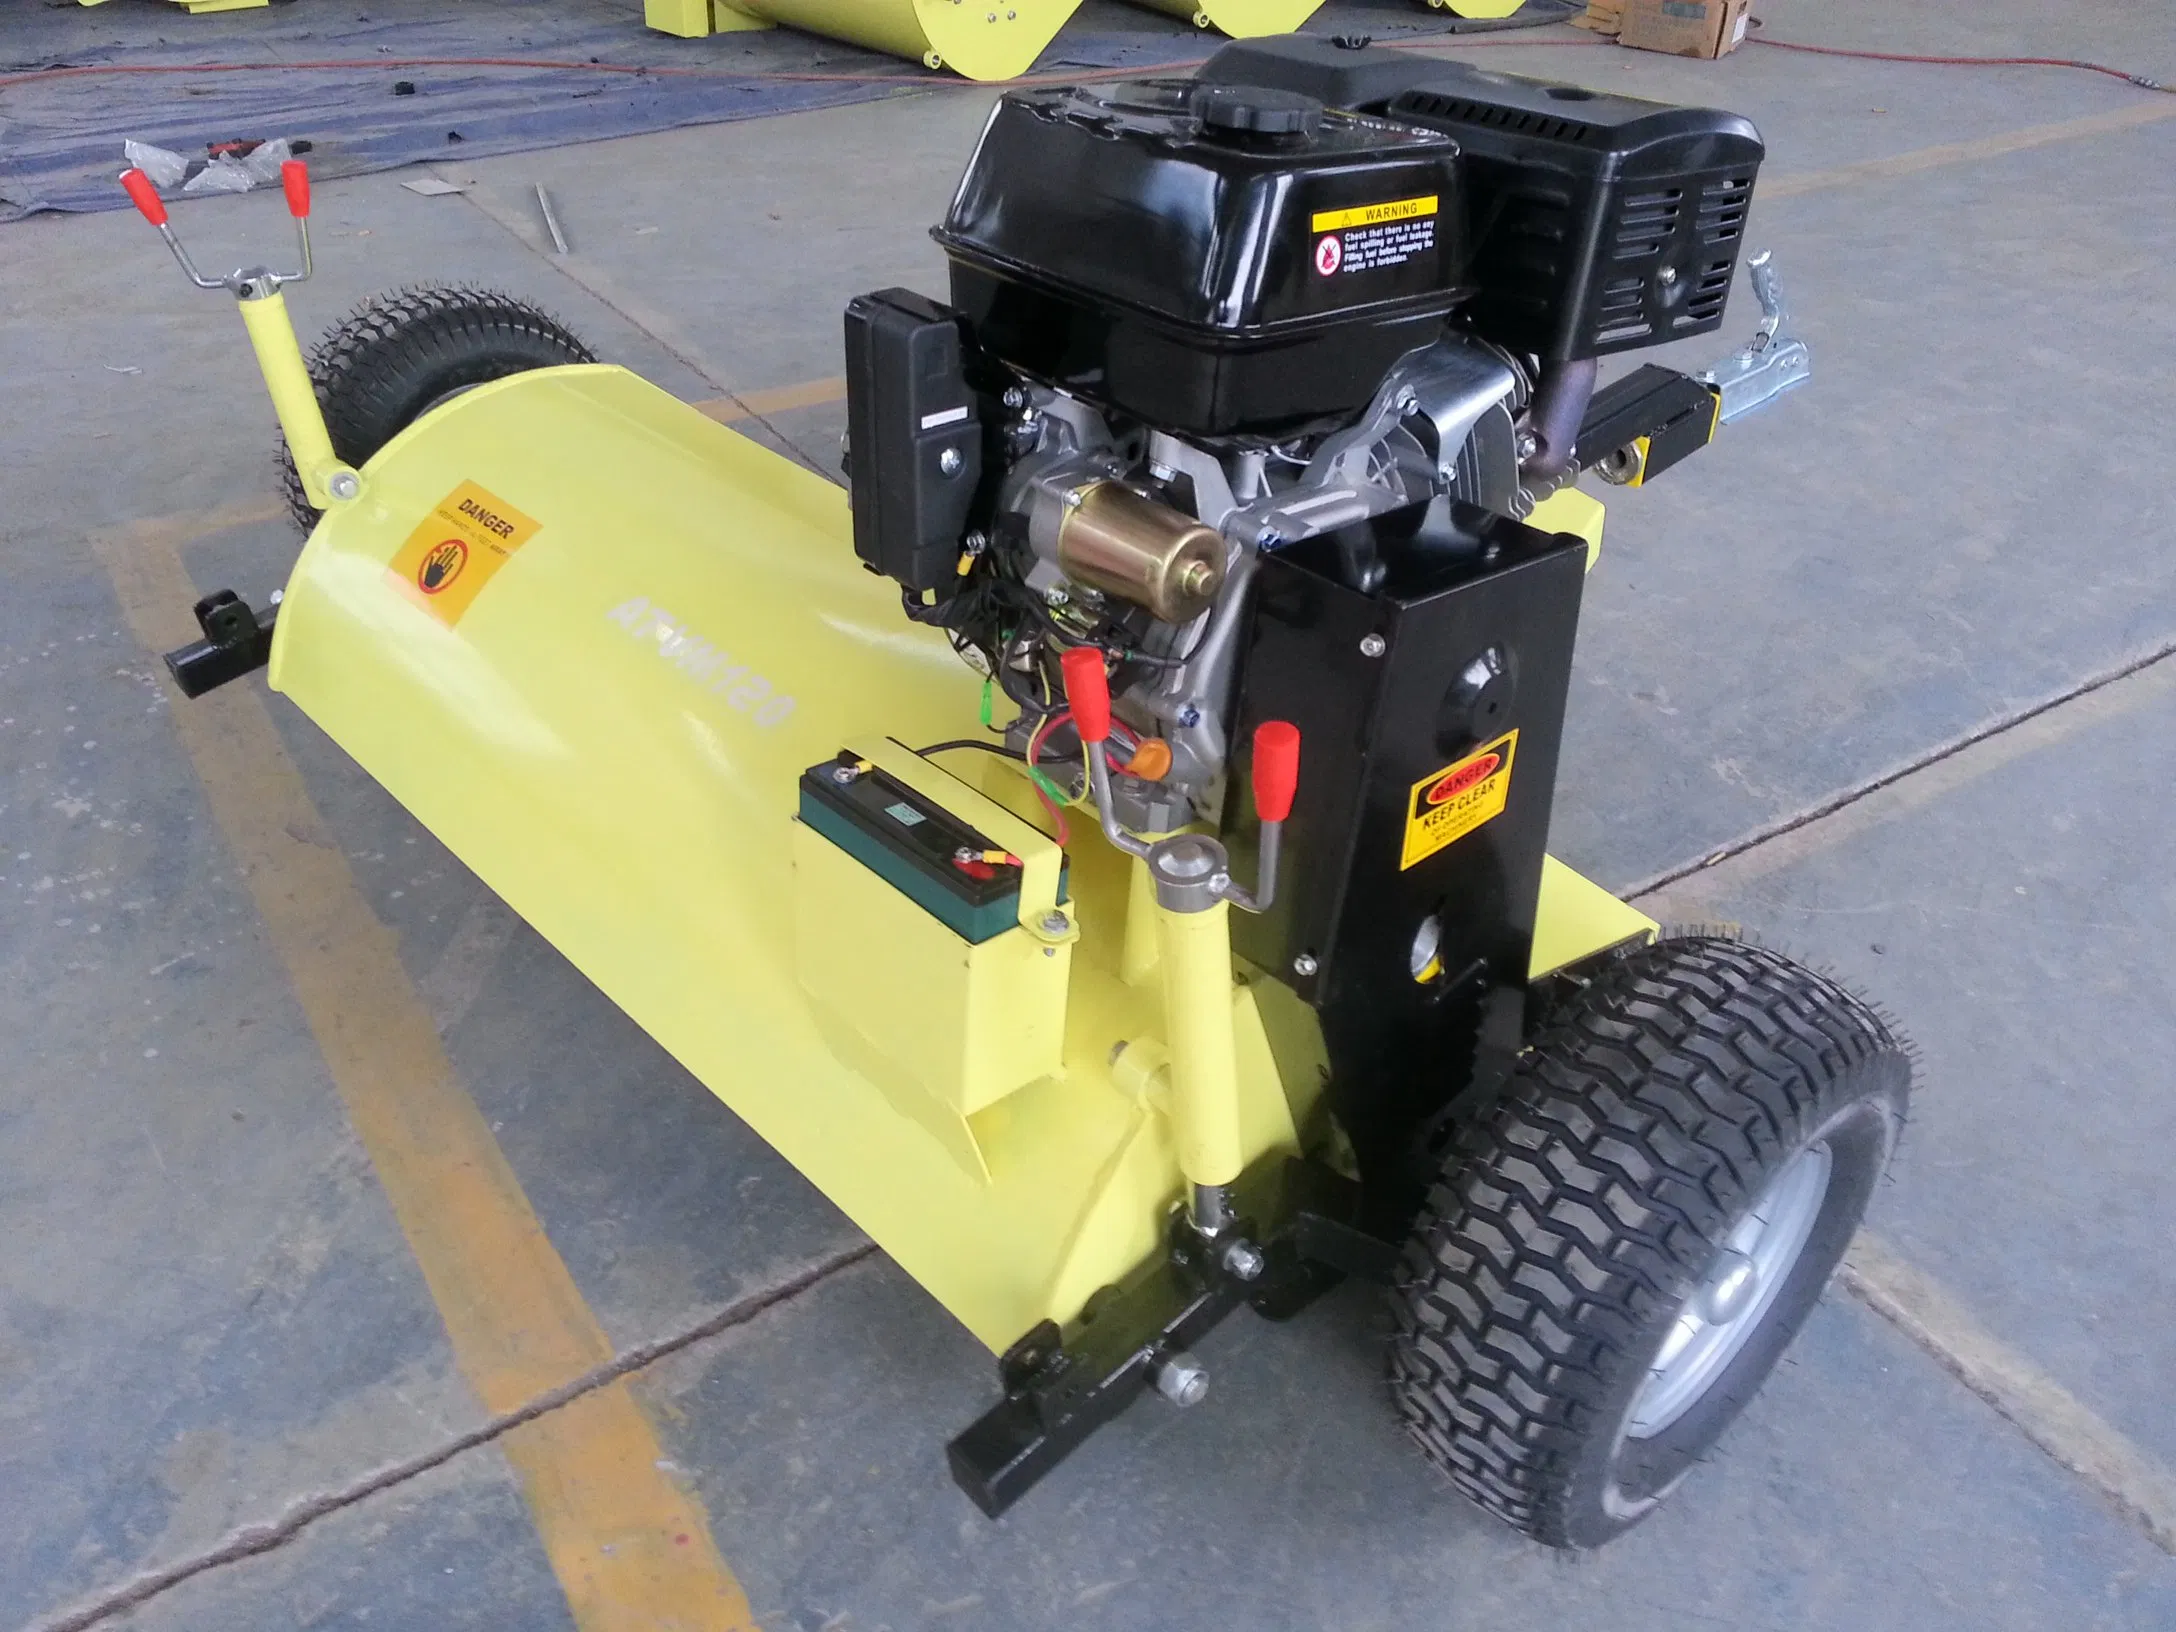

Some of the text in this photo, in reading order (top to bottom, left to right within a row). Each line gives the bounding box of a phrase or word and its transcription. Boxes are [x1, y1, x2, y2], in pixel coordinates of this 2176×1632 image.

[1366, 202, 1418, 221] WARNING
[1345, 220, 1435, 242] Check that there is no any
[1344, 252, 1363, 263] Filling
[1365, 249, 1378, 260] fuel
[1379, 246, 1397, 257] before
[1424, 239, 1434, 248] the
[1345, 241, 1358, 252] fuel
[1360, 238, 1385, 250] spilling
[1386, 236, 1394, 245] or
[1396, 234, 1408, 244] fuel
[1343, 260, 1366, 273] engine
[1368, 258, 1375, 268] is
[458, 498, 516, 540] DANGER
[1435, 758, 1493, 801] DANGER
[1423, 779, 1496, 830] KEEP CLEAR
